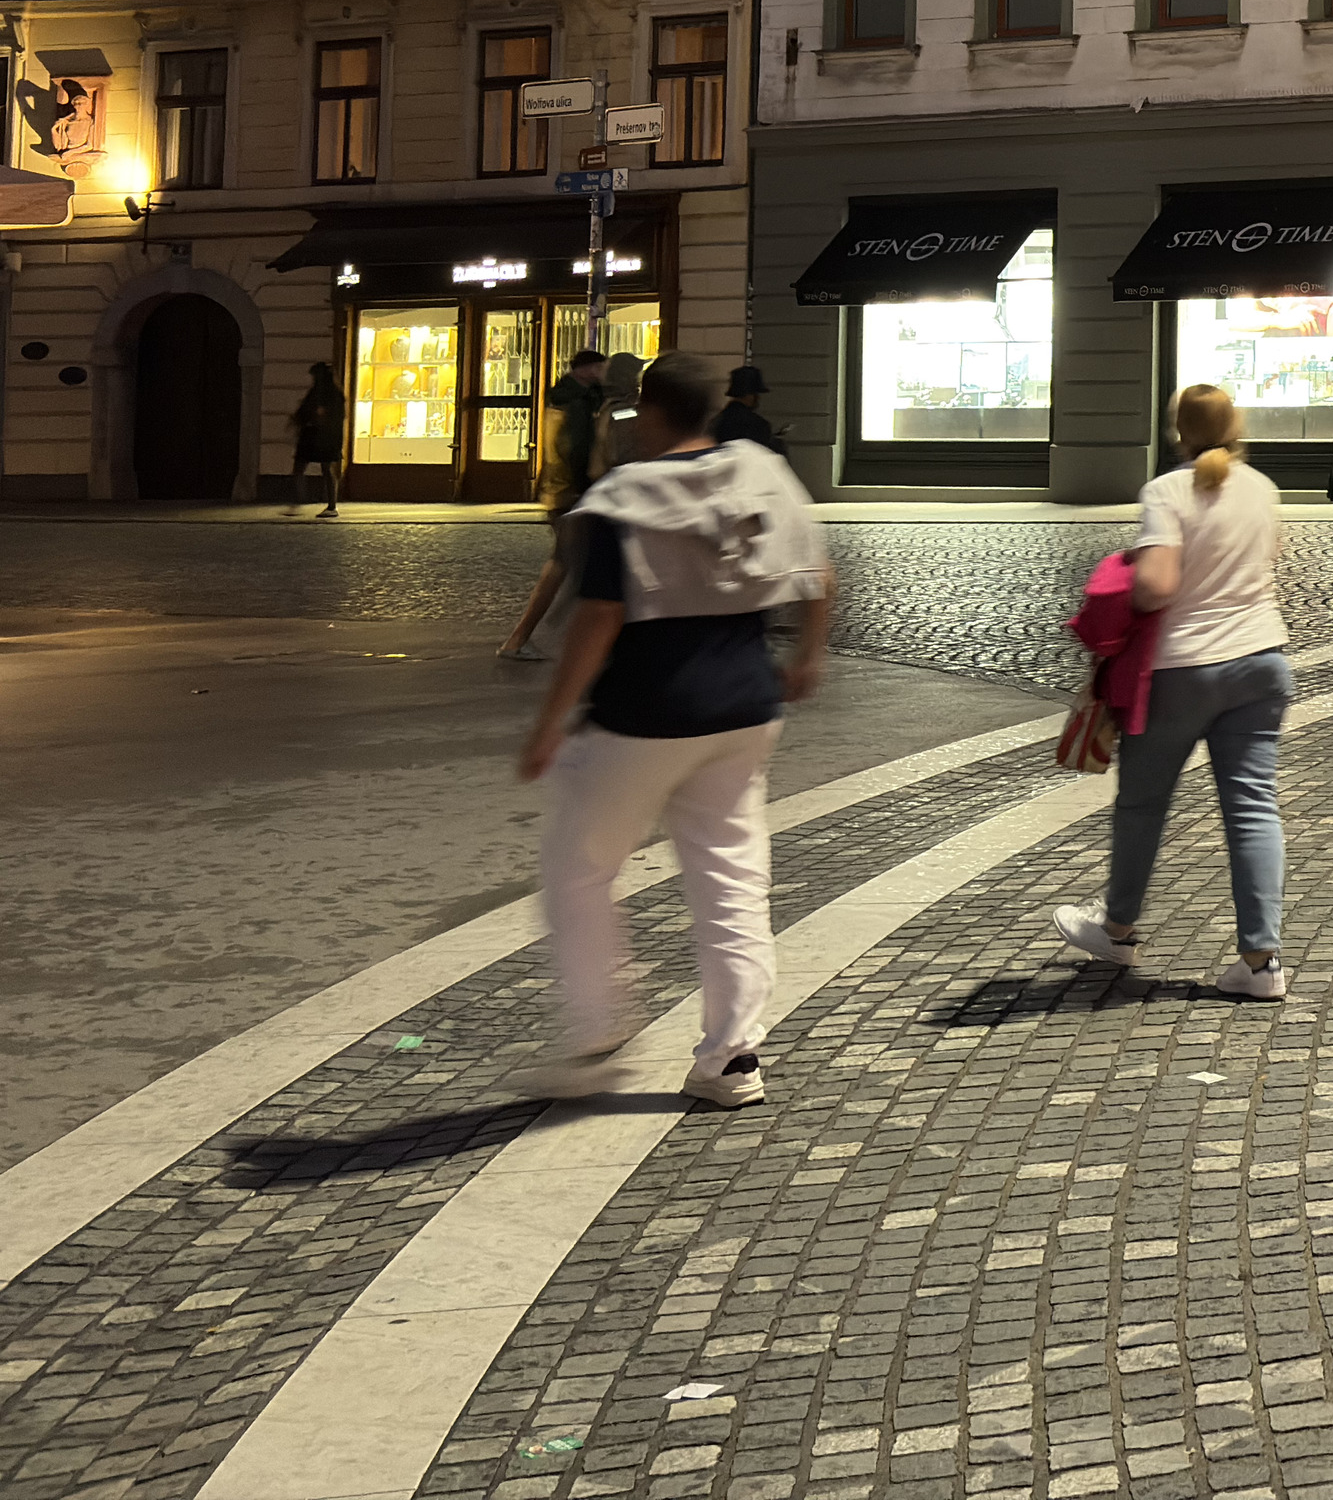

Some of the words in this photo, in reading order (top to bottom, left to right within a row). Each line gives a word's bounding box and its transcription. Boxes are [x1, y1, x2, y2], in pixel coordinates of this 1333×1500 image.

[556, 95, 572, 107] ulica
[616, 122, 646, 135] Prešernov
[848, 239, 908, 257] STEN
[943, 235, 1004, 253] TIME
[1166, 229, 1235, 248] STEN
